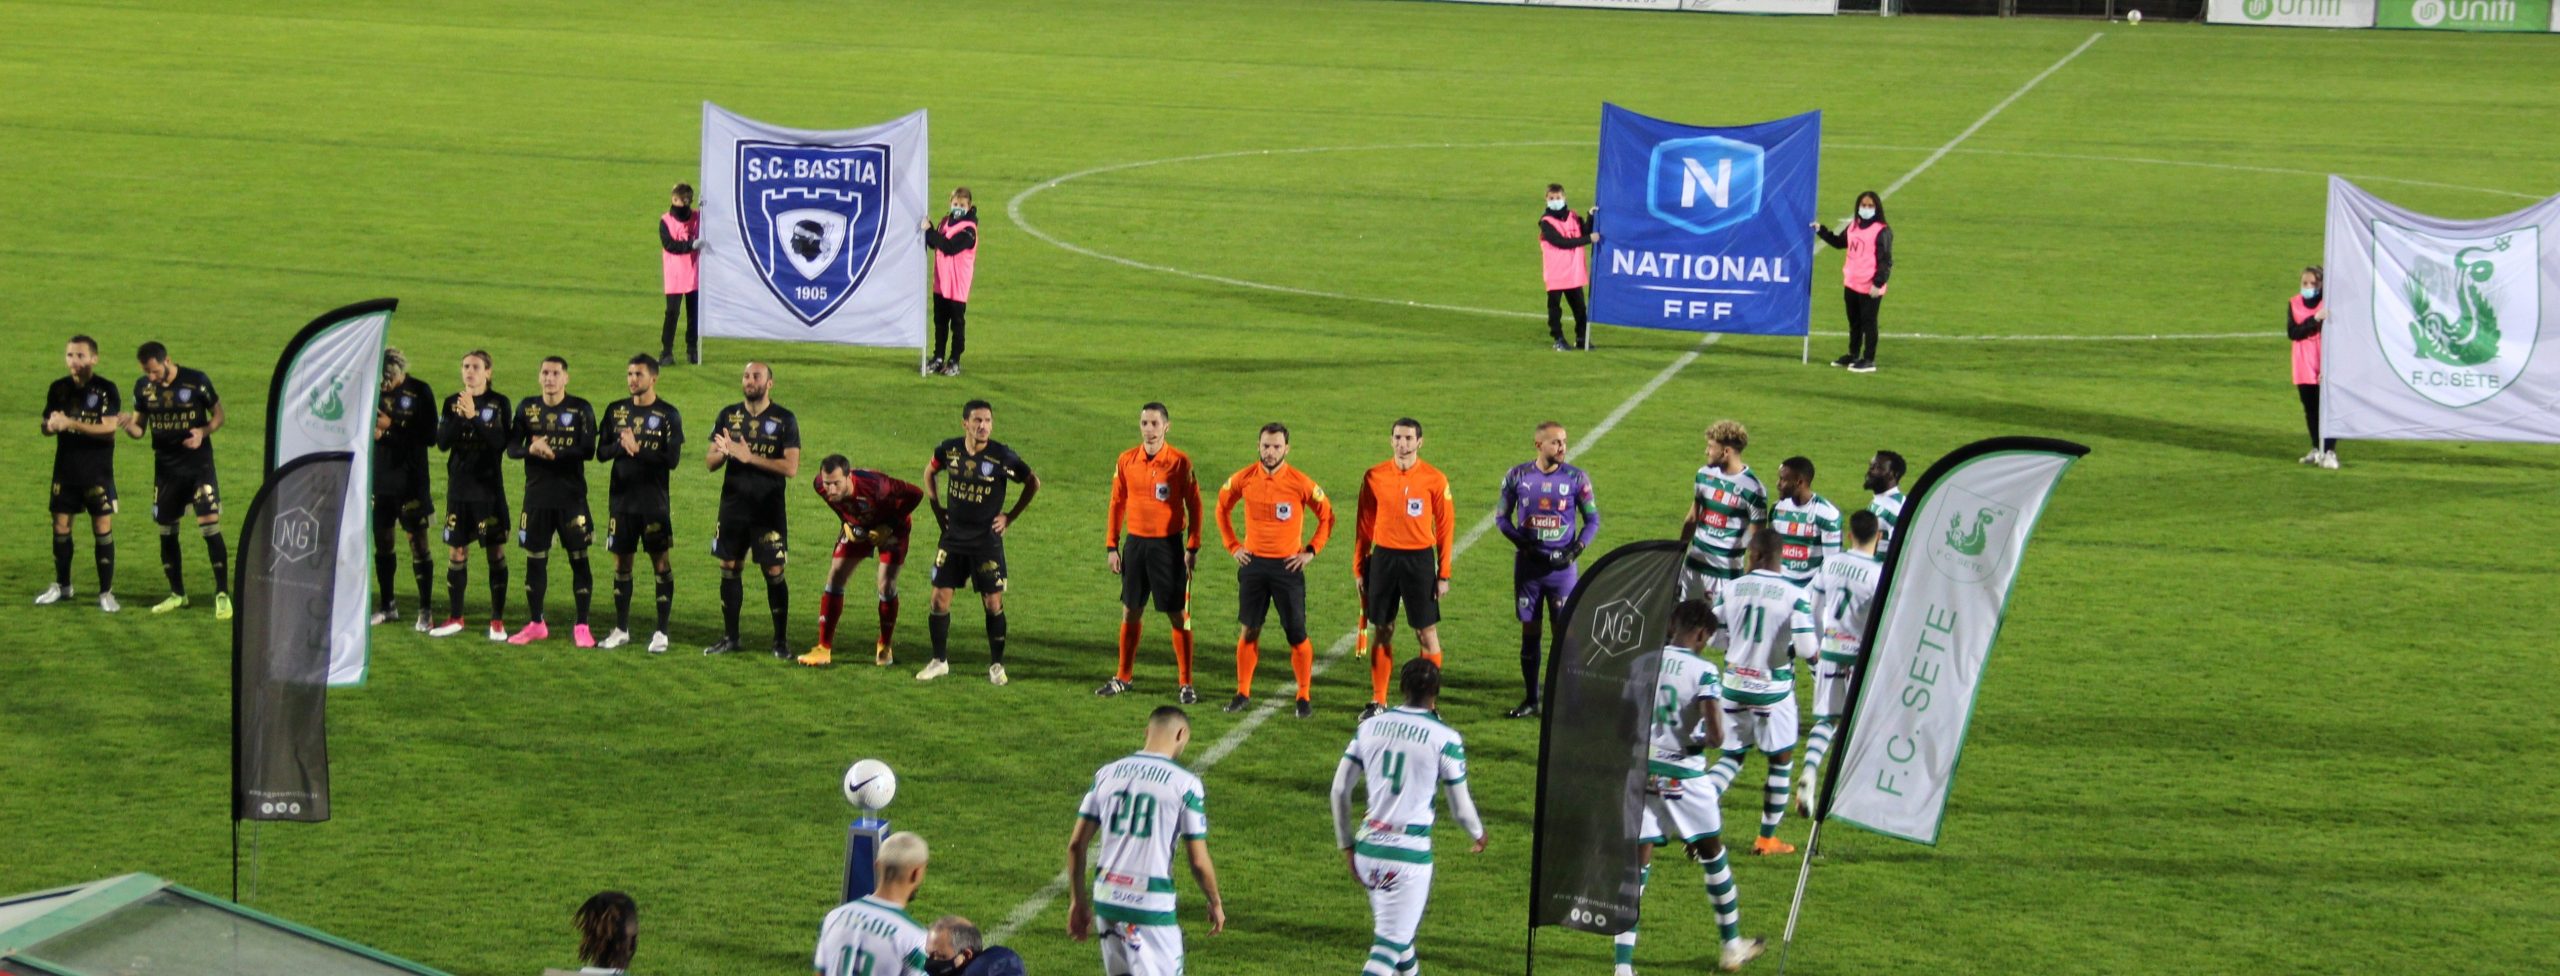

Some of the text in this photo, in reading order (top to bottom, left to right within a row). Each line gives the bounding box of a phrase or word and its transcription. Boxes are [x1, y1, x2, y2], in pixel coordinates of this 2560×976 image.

[748, 156, 877, 186] S.C. BASTIA
[1680, 157, 1733, 208] N
[1612, 248, 1790, 283] NATIONAL
[795, 287, 828, 301] 1905
[1663, 299, 1733, 321] FFF
[281, 519, 310, 549] NG
[1543, 529, 1560, 537] pro
[1707, 527, 1726, 537] pro
[1790, 560, 1808, 571] pro
[1834, 586, 1853, 621] 7
[1600, 611, 1634, 644] NG
[1742, 603, 1765, 643] 11
[1373, 721, 1431, 745] DIARRA
[1382, 749, 1405, 796] 4
[1110, 789, 1157, 838] 28
